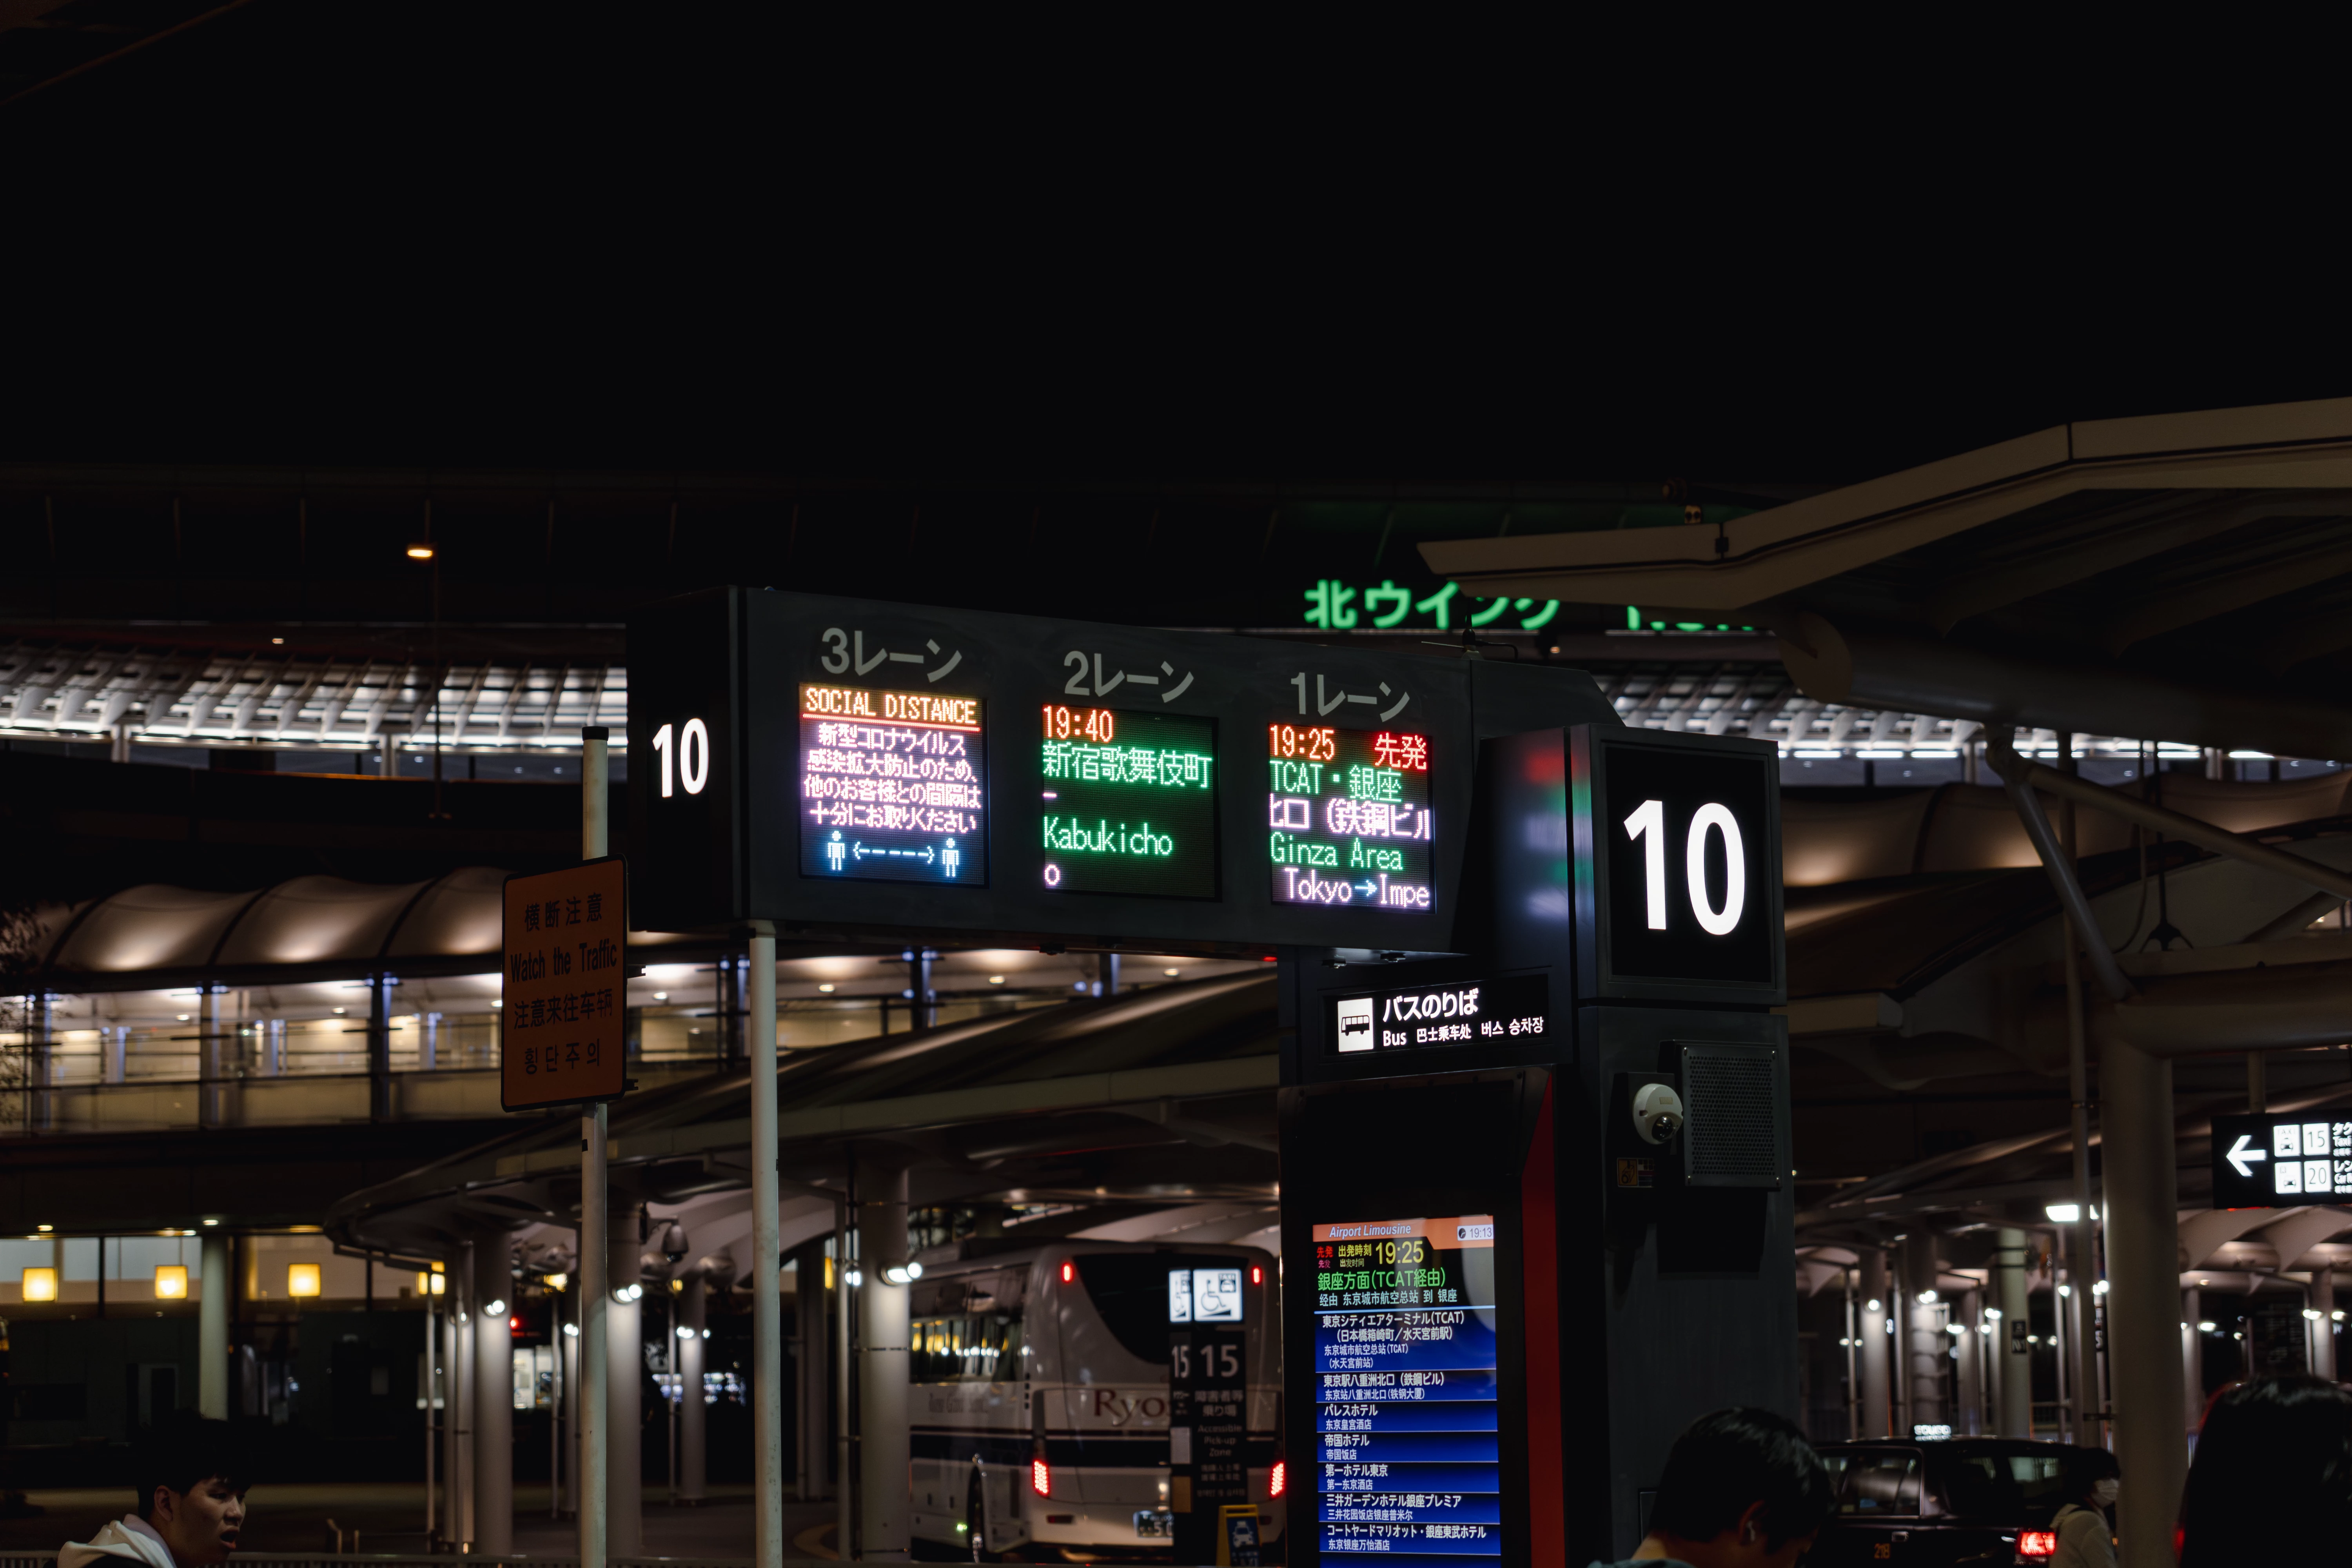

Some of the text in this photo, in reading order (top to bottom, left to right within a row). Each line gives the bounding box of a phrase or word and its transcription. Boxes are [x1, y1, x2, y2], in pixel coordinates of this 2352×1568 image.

[820, 627, 962, 683] 3レーン
[1064, 650, 1194, 703] 2レーン
[806, 687, 976, 724] SOCIAL DISTANCE
[1291, 672, 1410, 722] 1レーン
[818, 722, 966, 755] 新型コロナウイルス
[1043, 706, 1114, 742] 19:40
[652, 718, 709, 798] 10
[1043, 740, 1212, 788] 新宿歌舞伎町
[1270, 725, 1426, 769] 19:25 先発
[804, 773, 981, 809] 他のお客様との間隔は
[810, 800, 976, 834] 十分にお取りください
[1044, 815, 1172, 855] Kabukicho
[1271, 831, 1403, 870] Ginza Area
[1624, 800, 1744, 935] 10
[1285, 867, 1429, 907] Tokyo Impe
[524, 892, 602, 932] 横断注意
[510, 938, 617, 983] Watch the Traffic
[514, 988, 612, 1030] 注意来往车辆
[1383, 987, 1479, 1022] バスのりば
[1383, 1030, 1406, 1046] Bus
[1481, 1020, 1504, 1037] 버스
[1509, 1016, 1544, 1036] 승차장
[2307, 1130, 2325, 1148] 15
[2308, 1167, 2327, 1184] 20
[1329, 1224, 1492, 1239] Airport Limousine 19:13
[1316, 1241, 1423, 1264] 先発 出発時刻 19:25
[1318, 1267, 1446, 1290] 銀座方面(TCAT経由)
[1319, 1289, 1457, 1307] 经由 东京城市航空总站 到 银座
[1322, 1311, 1464, 1328] 東京シティエアターミナル(TCAT)
[1171, 1345, 1191, 1378] 15
[1200, 1344, 1240, 1378] 15
[1324, 1403, 1378, 1417] パレスホテル
[1198, 1424, 1243, 1433] Accessible
[1325, 1434, 1370, 1447] 帝国ホテル
[1209, 1448, 1232, 1457] Zone
[1327, 1449, 1357, 1461] 帝国饭店
[1325, 1463, 1388, 1477] 第一ホテル東京
[1327, 1479, 1372, 1490] 第一东京酒店
[1327, 1494, 1462, 1508] 三井ガーデンホテル銀座プレミア
